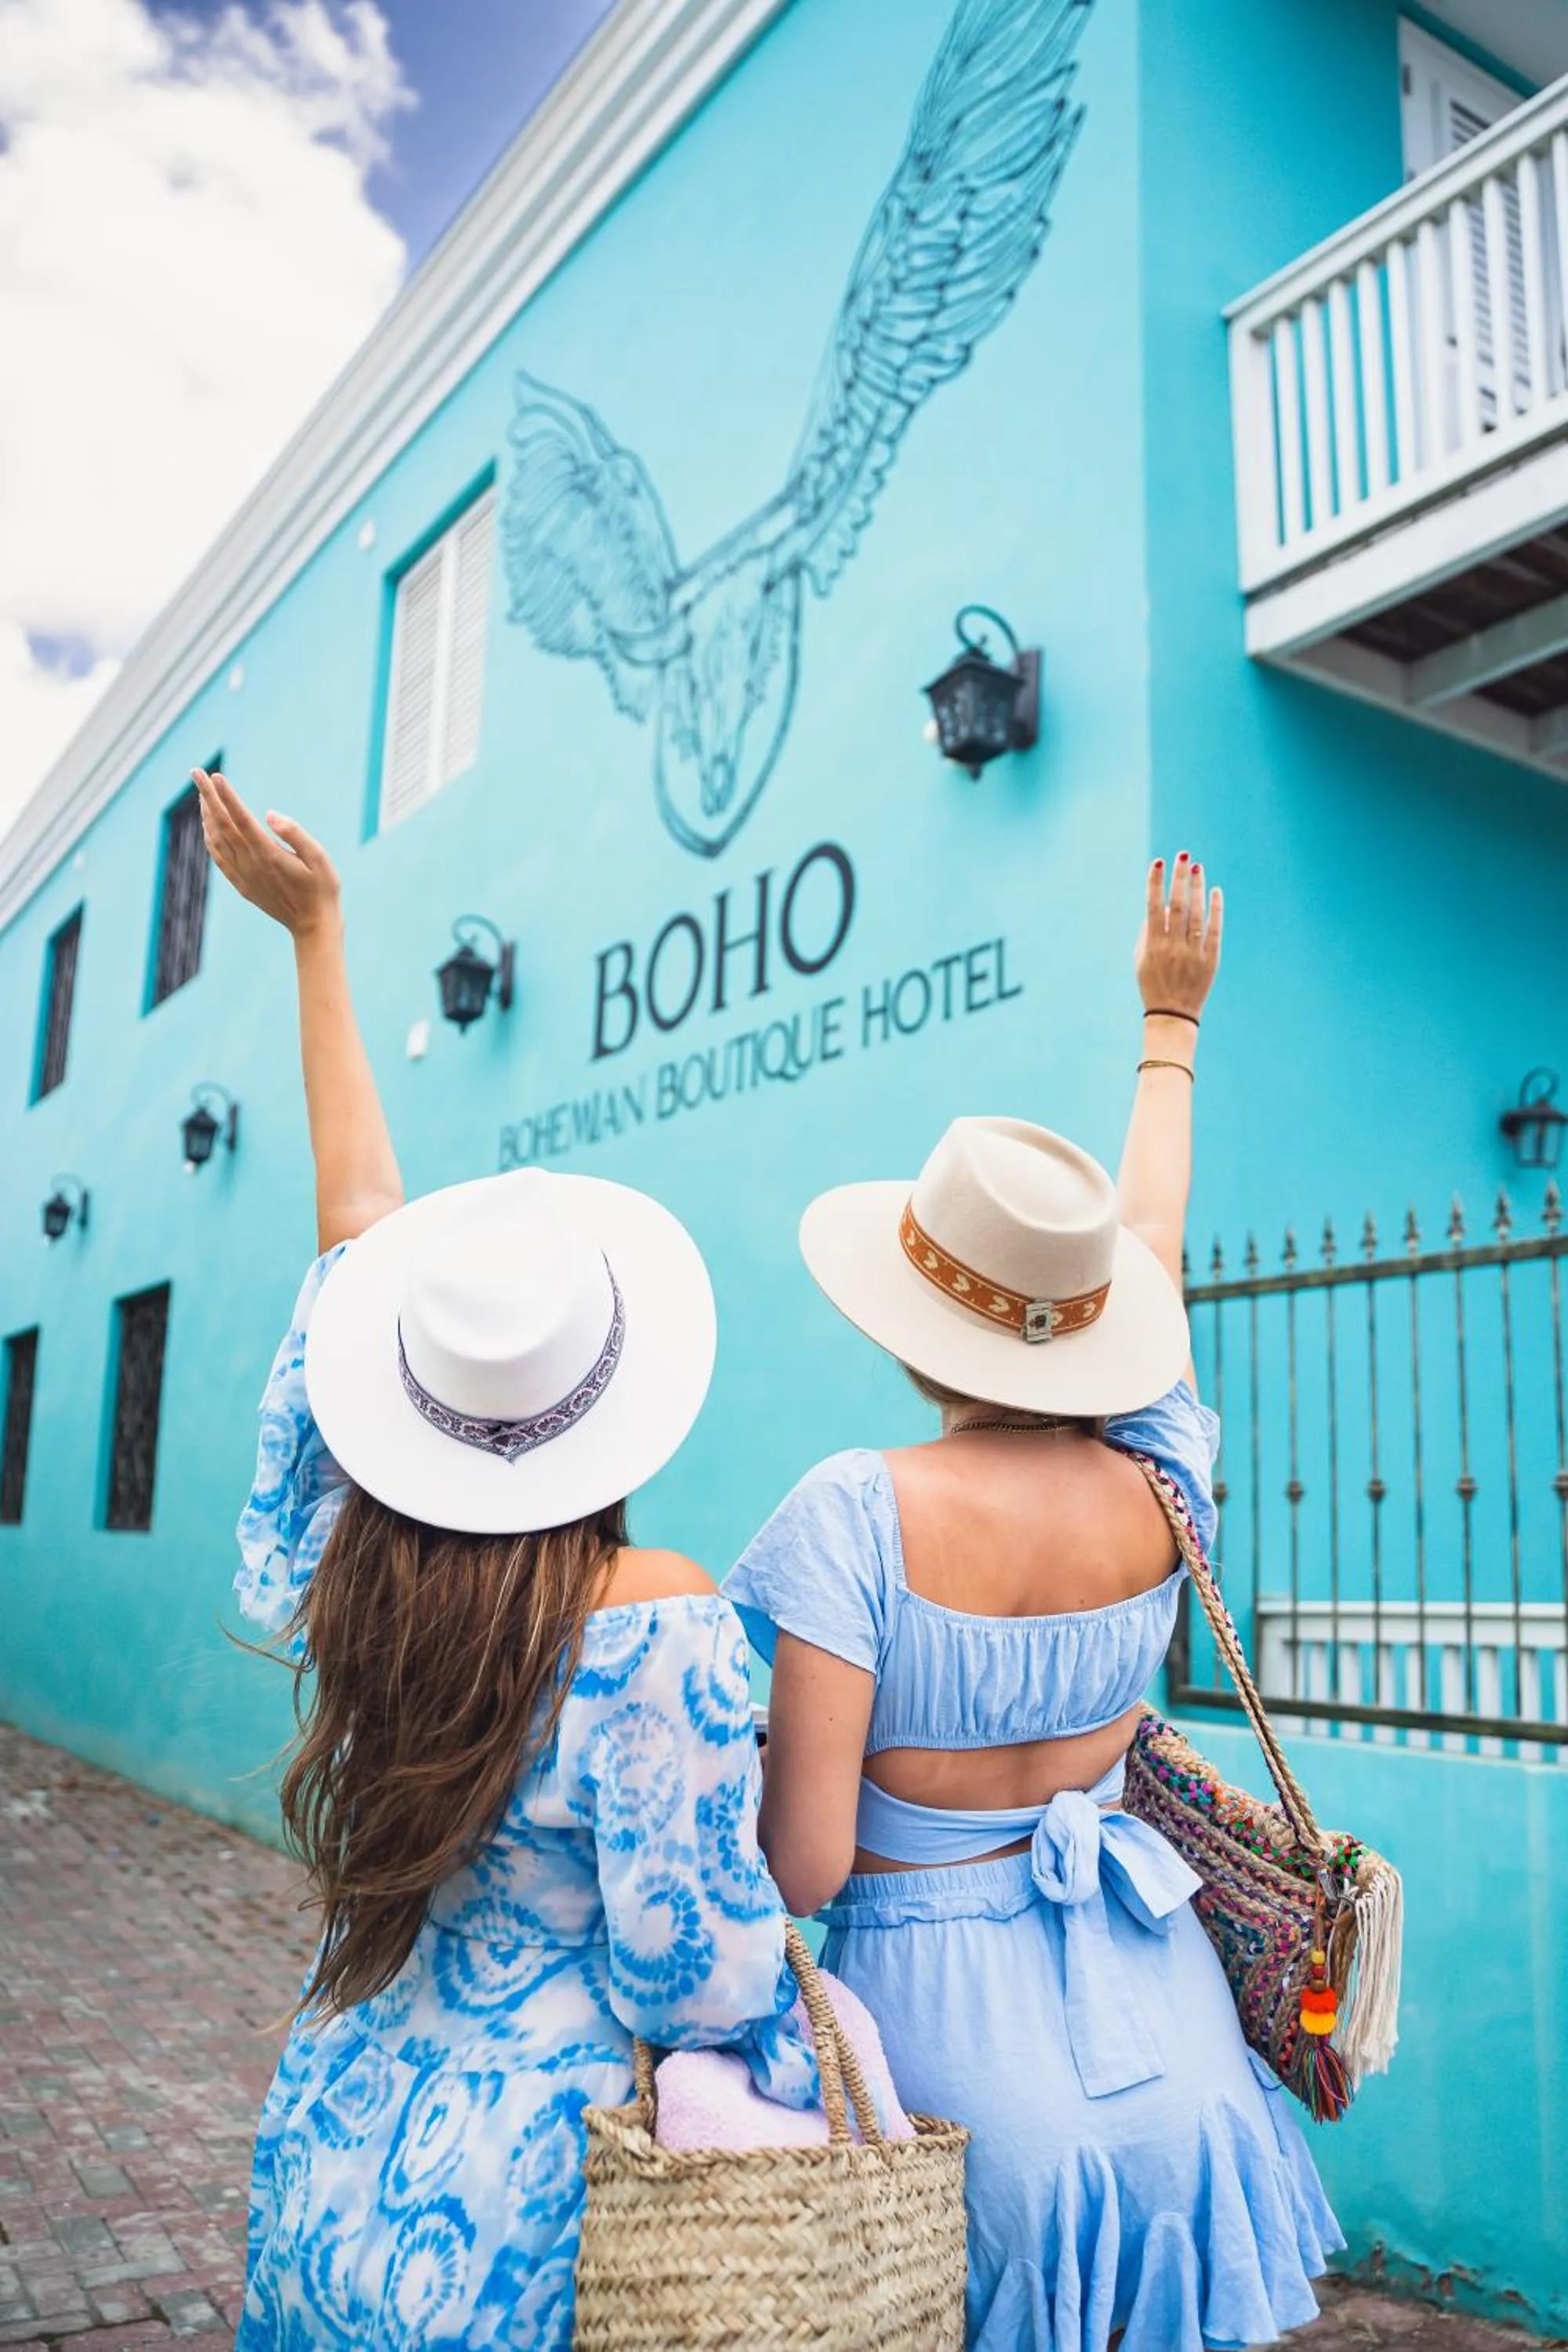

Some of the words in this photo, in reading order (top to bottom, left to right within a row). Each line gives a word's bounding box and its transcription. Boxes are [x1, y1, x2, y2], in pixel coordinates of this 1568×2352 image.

[590, 840, 857, 1063] BOHO
[655, 997, 845, 1120] BOUTIQUE
[862, 937, 1024, 1048] HOTEL
